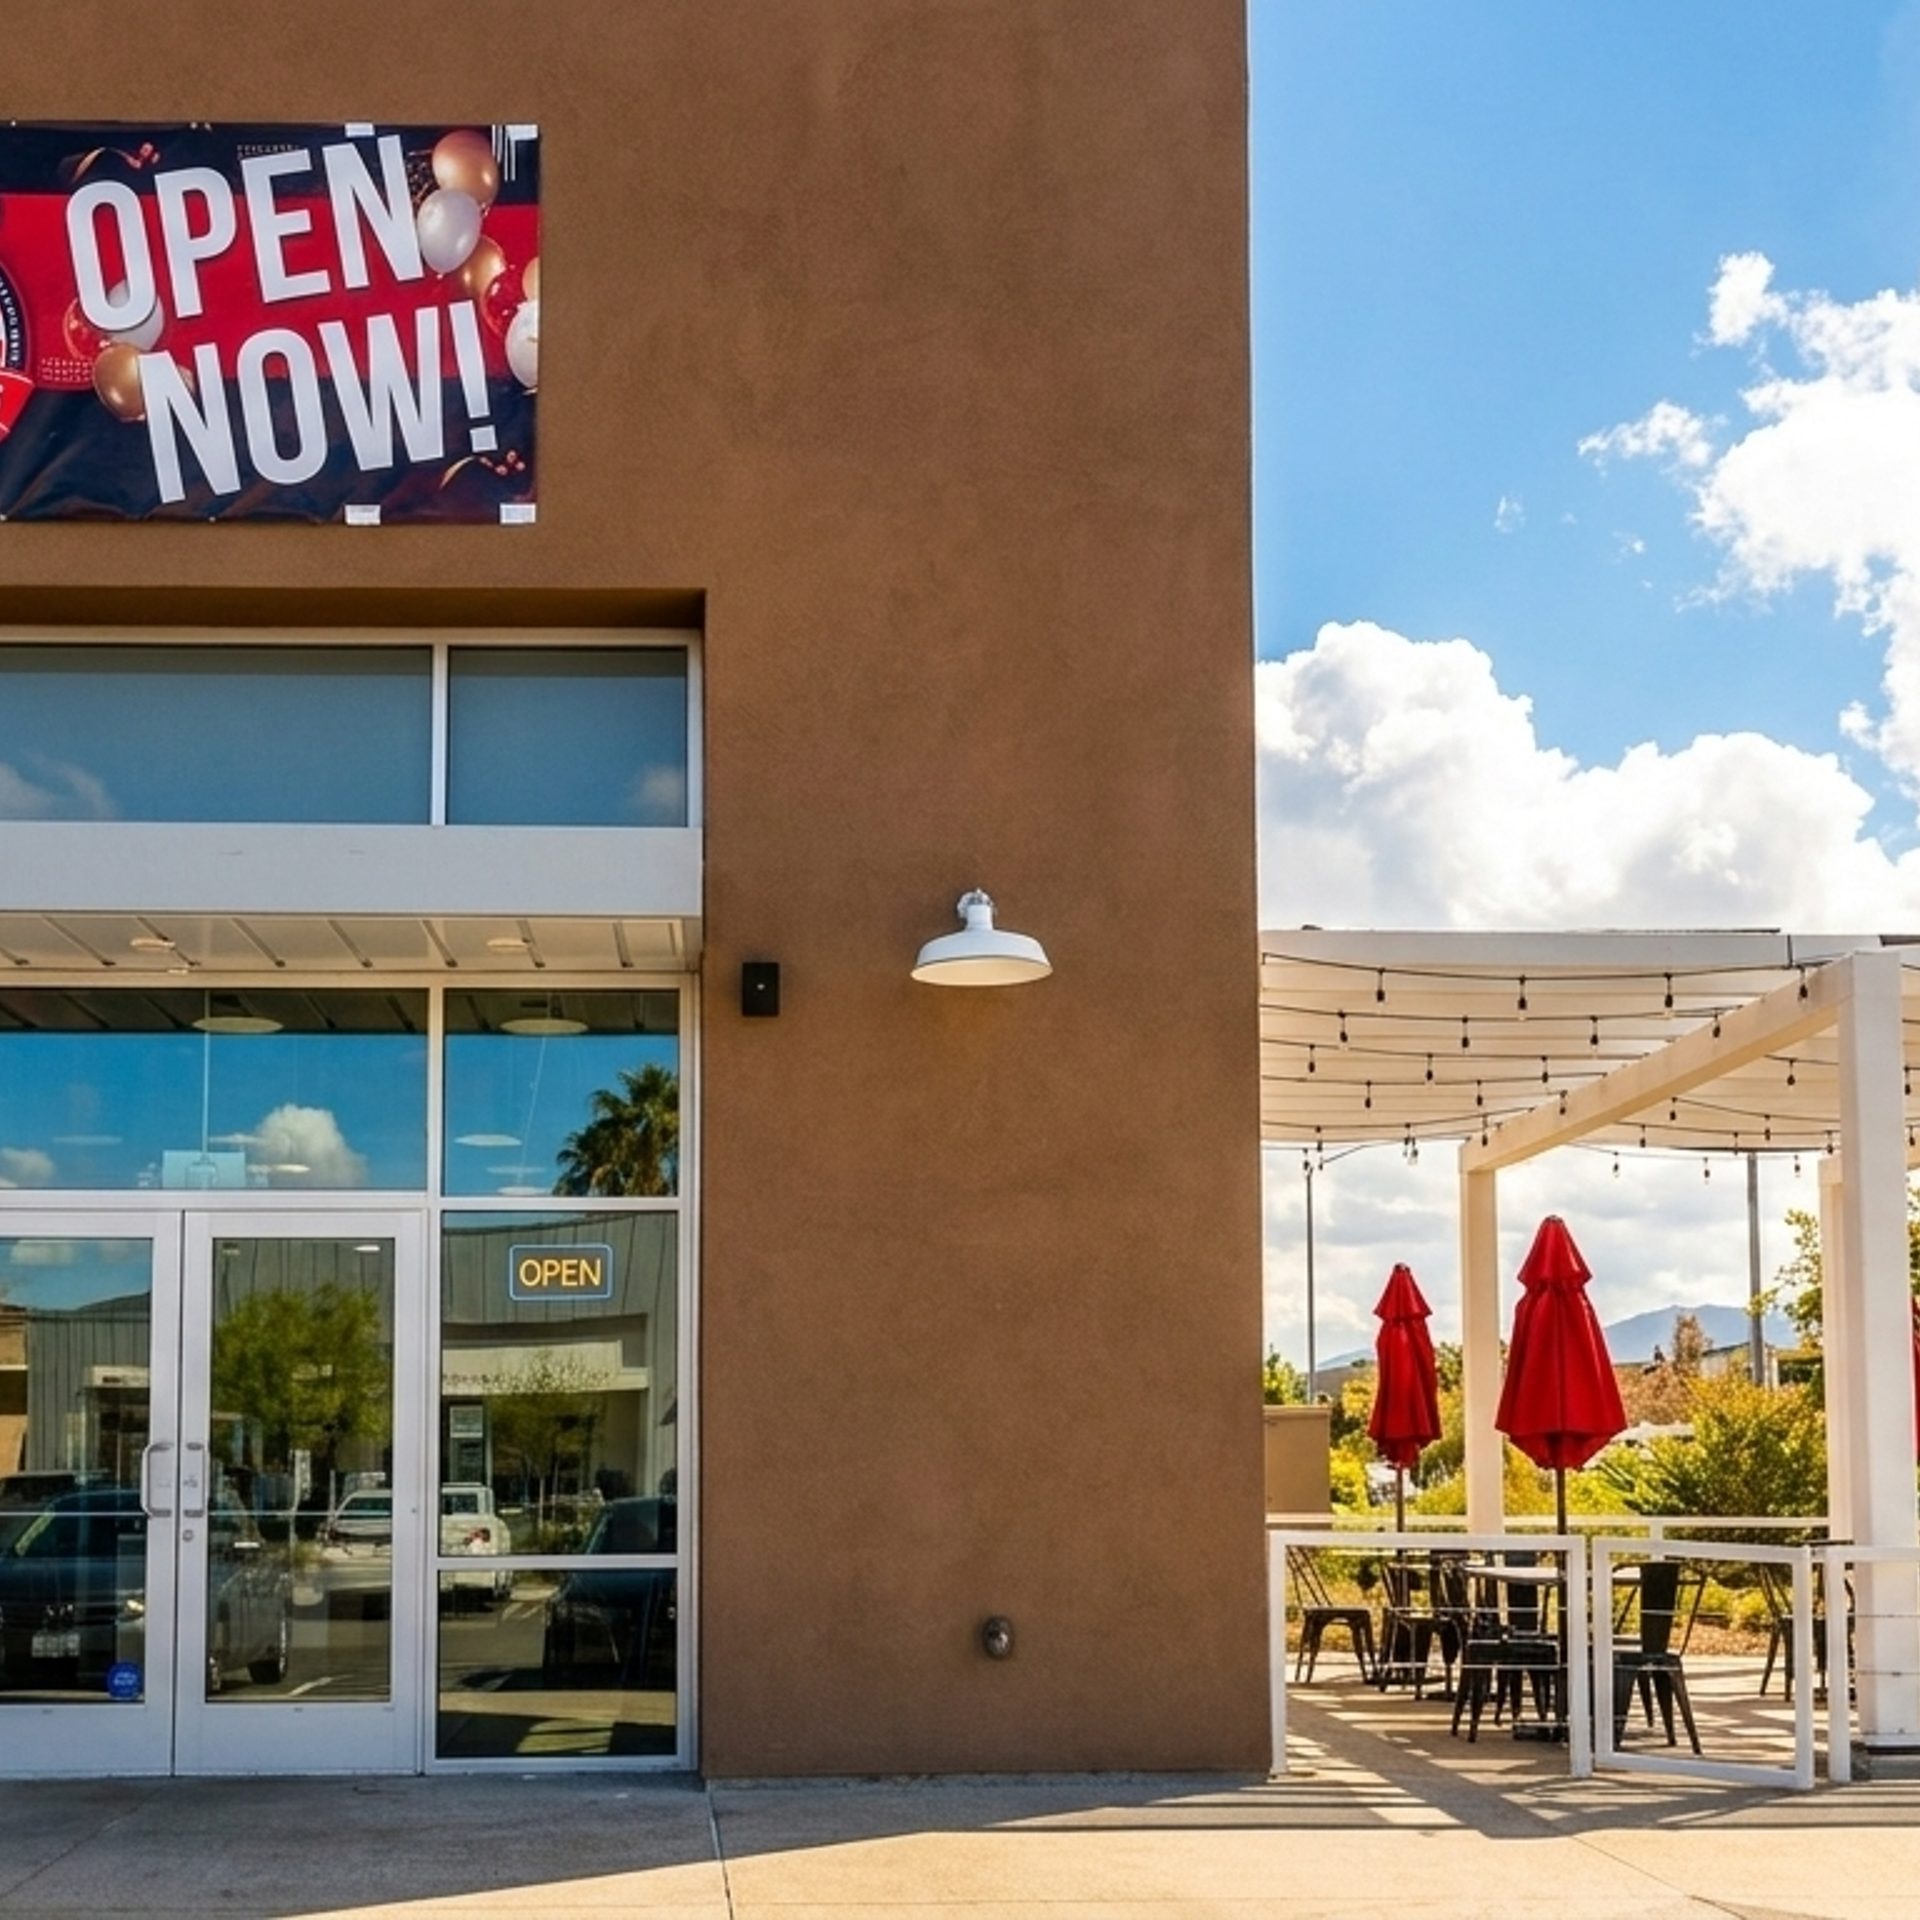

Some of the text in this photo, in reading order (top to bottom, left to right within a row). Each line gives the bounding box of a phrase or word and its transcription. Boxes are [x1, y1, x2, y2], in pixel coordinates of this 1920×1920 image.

[66, 134, 425, 331] OPEN
[138, 299, 499, 504] NOW!
[519, 1258, 602, 1287] OPEN
